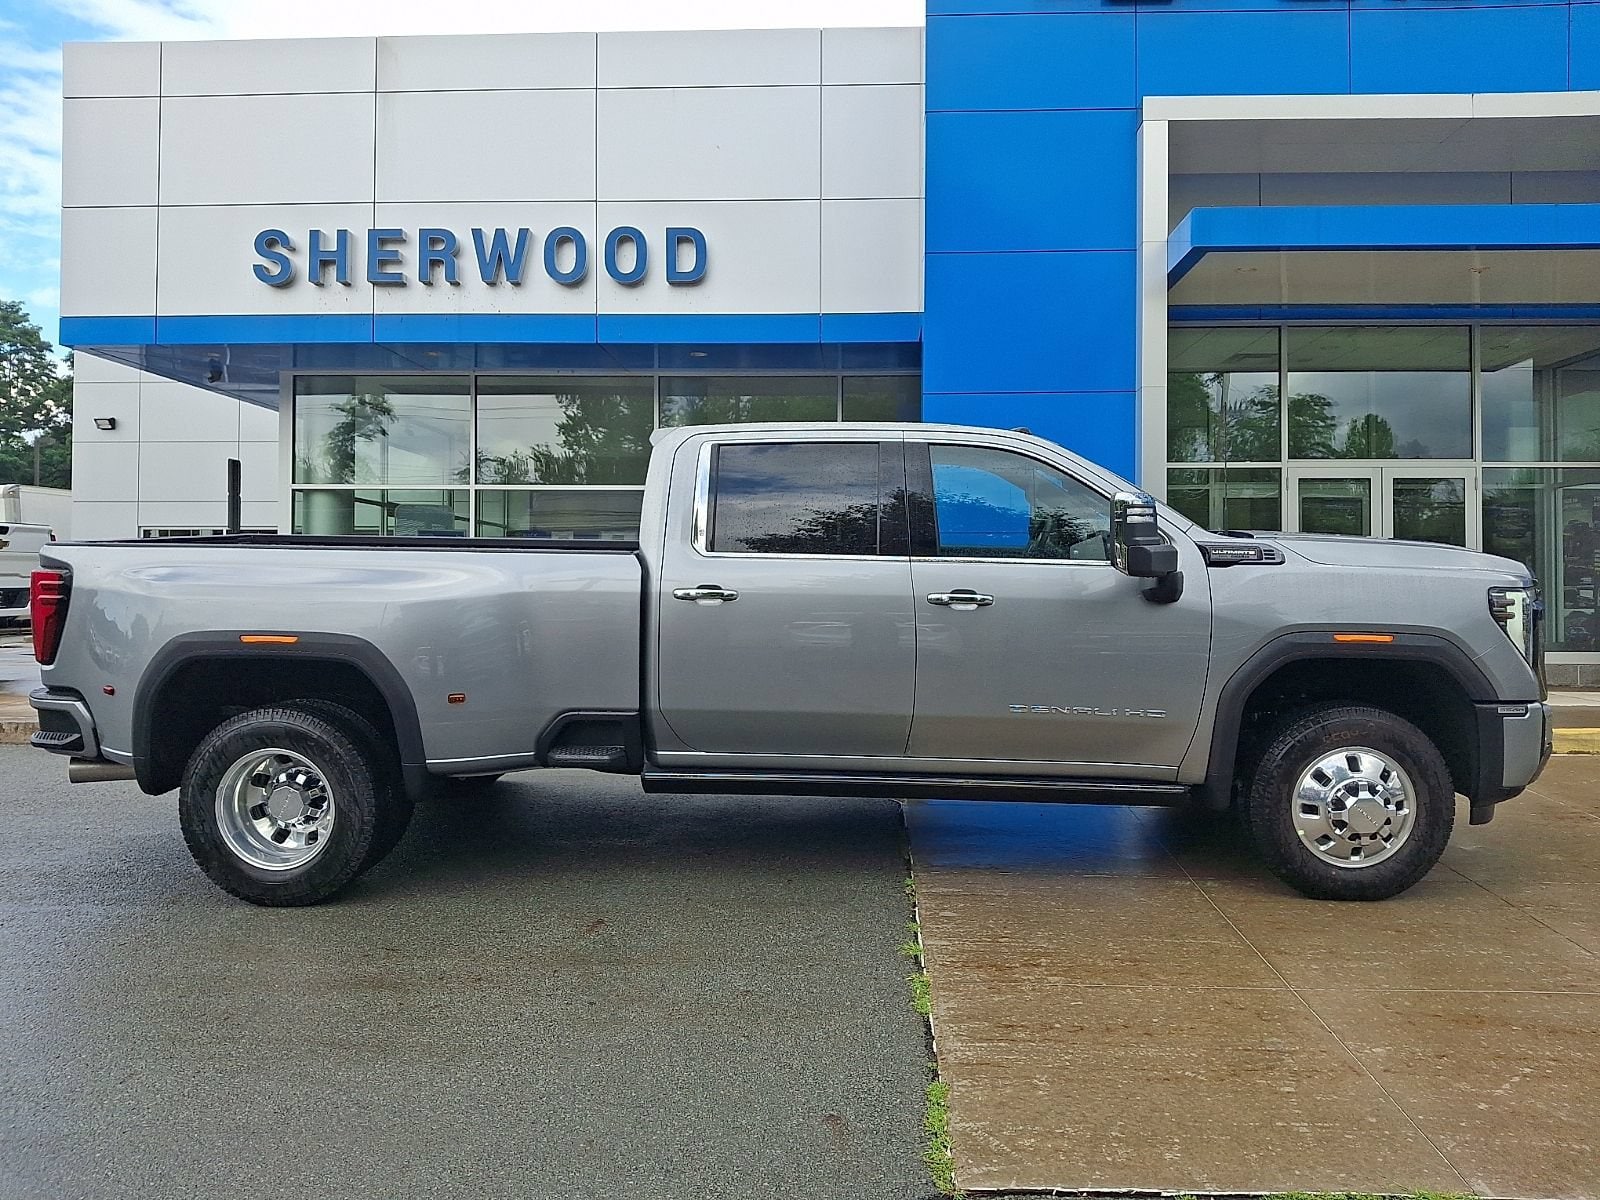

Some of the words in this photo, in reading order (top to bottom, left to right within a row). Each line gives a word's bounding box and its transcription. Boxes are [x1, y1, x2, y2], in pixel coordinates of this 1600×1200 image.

[252, 226, 709, 287] SHERWOOD
[1007, 703, 1118, 717] DENALI
[1124, 707, 1168, 719] HD
